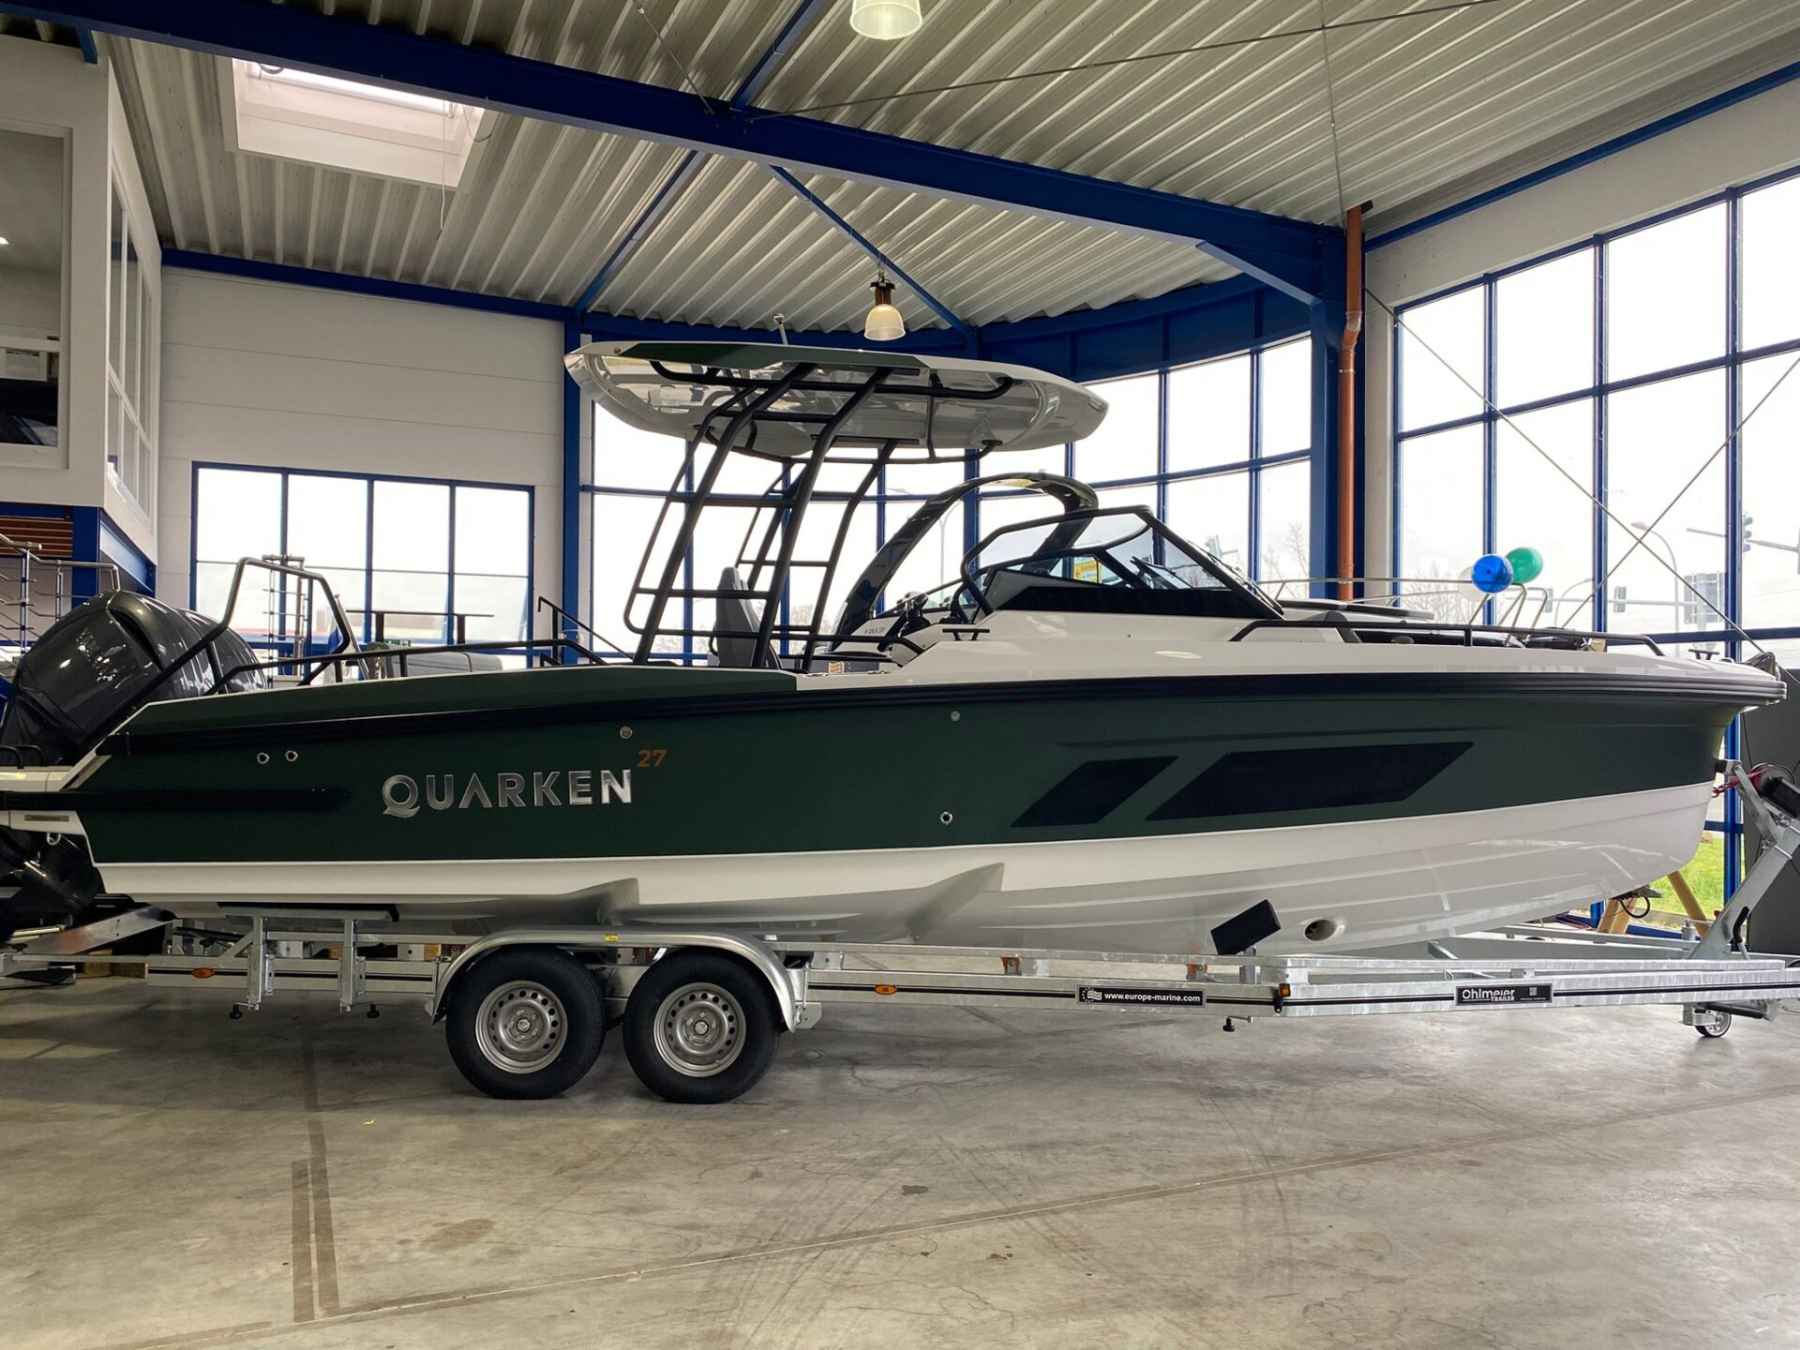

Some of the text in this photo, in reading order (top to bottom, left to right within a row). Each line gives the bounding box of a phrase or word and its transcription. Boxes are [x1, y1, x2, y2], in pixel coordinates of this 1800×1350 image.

[637, 749, 667, 768] 27
[382, 769, 632, 818] QUARKEN
[1104, 992, 1200, 1002] www.europe-marine.com
[1462, 988, 1515, 999] Ohlmeier
